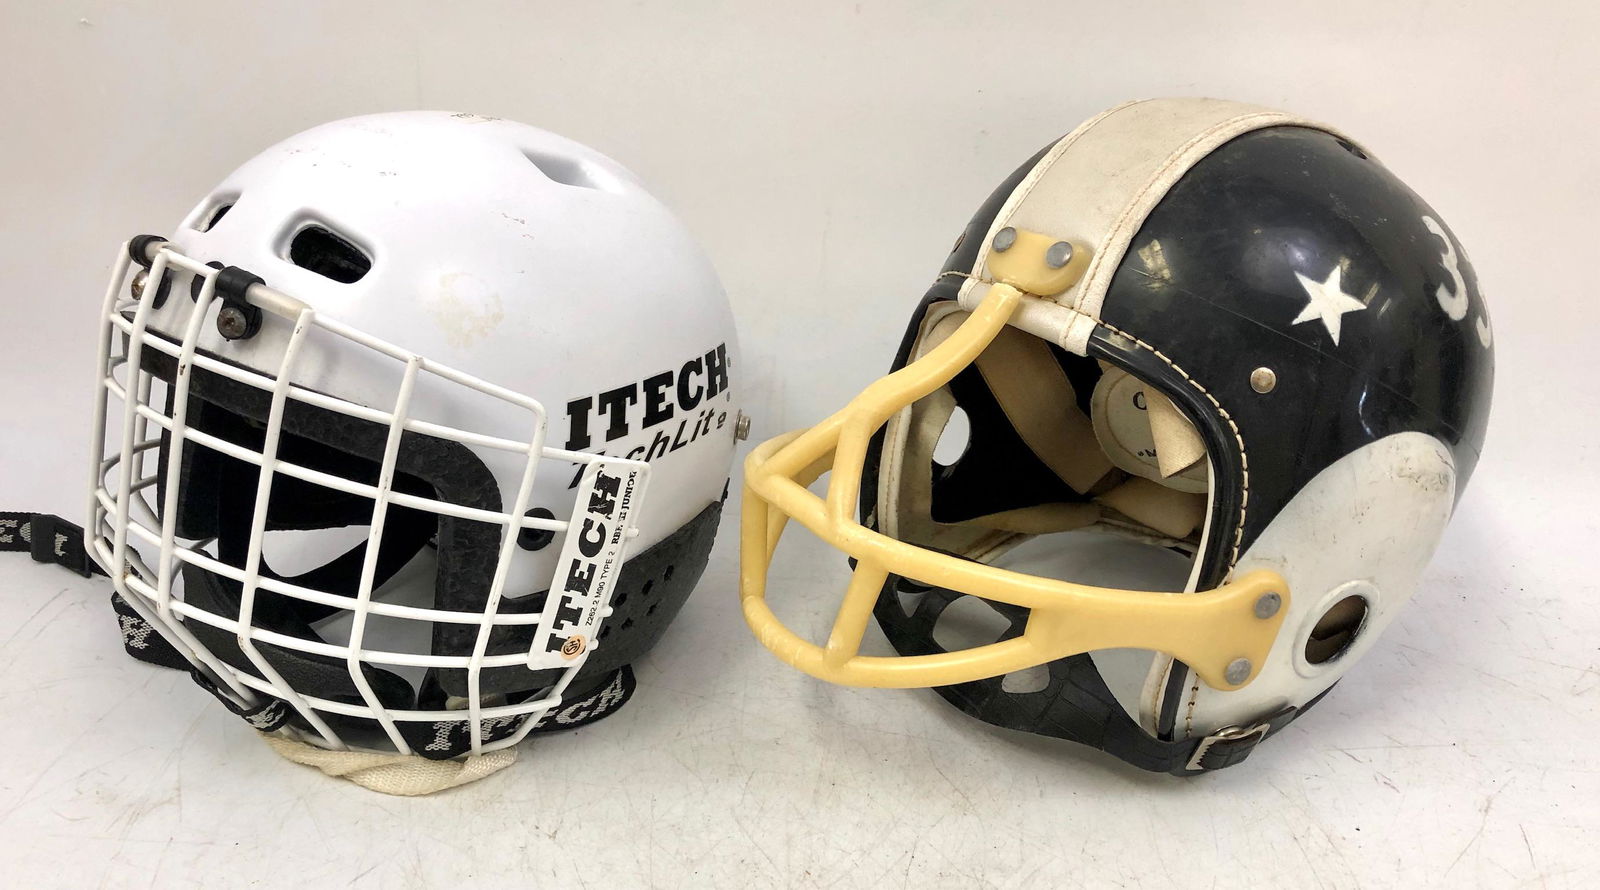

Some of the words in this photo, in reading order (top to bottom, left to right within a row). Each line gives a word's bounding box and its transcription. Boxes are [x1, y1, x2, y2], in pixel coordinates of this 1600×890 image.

[565, 342, 728, 451] ITECH
[568, 407, 727, 490] TchLite
[545, 464, 622, 653] ITECH
[600, 559, 613, 579] TYPE
